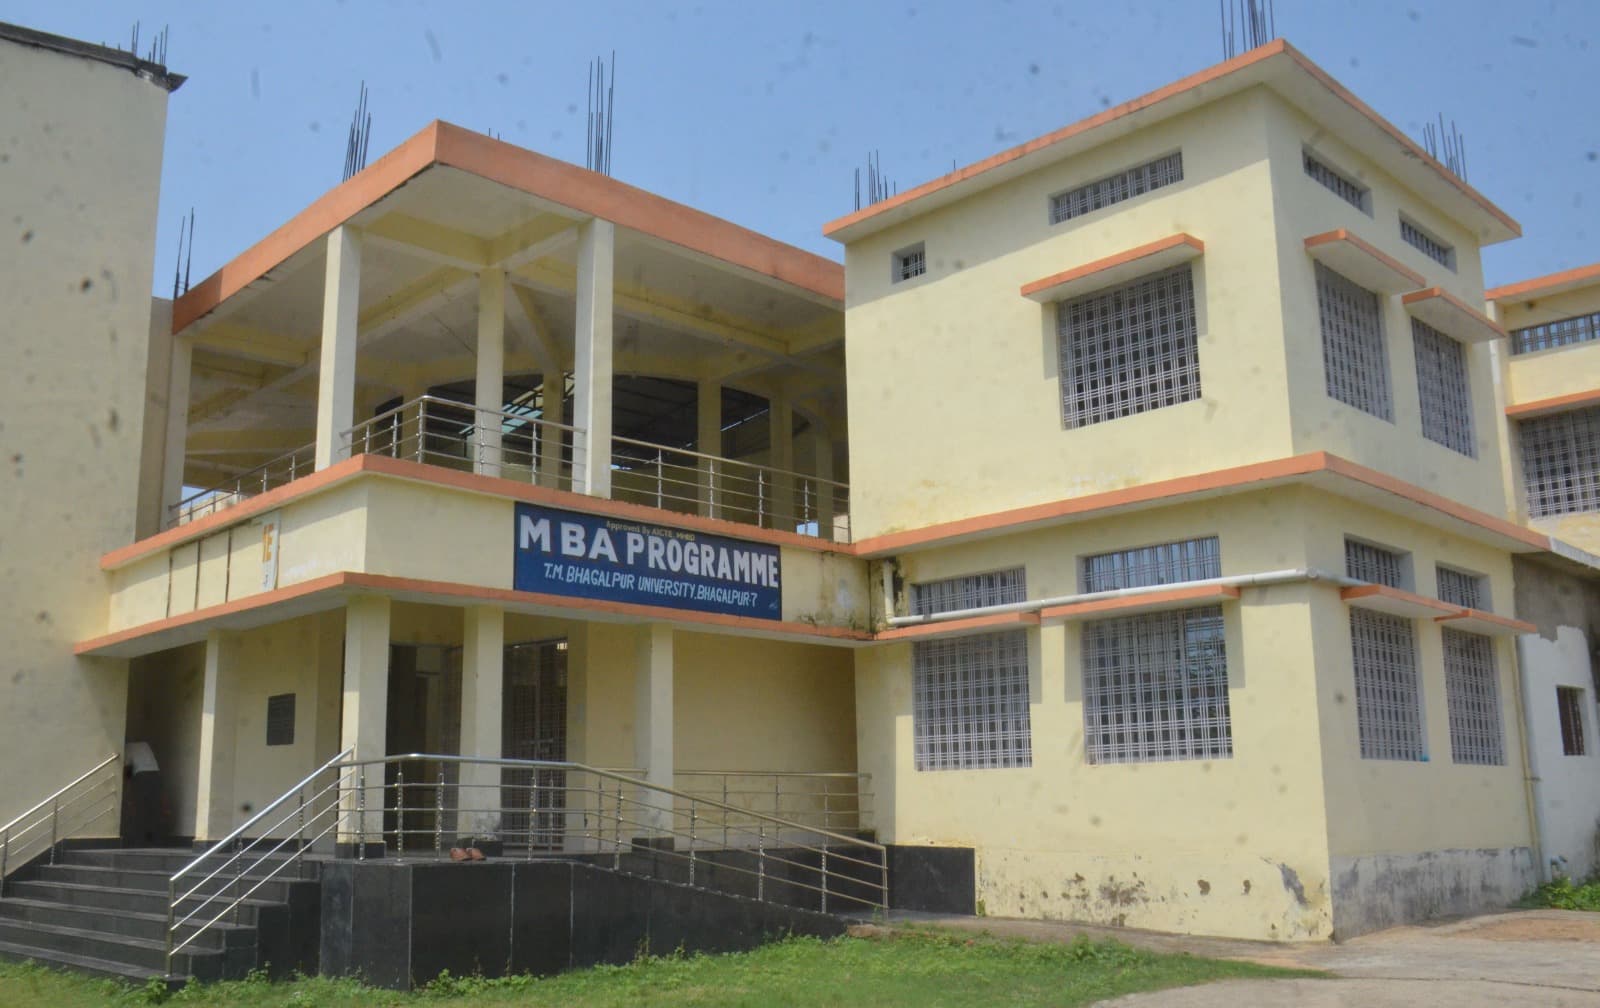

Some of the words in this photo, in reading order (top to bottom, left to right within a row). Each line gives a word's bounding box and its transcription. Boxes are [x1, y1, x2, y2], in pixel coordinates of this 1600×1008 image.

[606, 520, 640, 534] Approved
[626, 532, 779, 588] PROGRAMME
[544, 563, 564, 581] T.M.
[566, 565, 635, 590] BHAGALPUR
